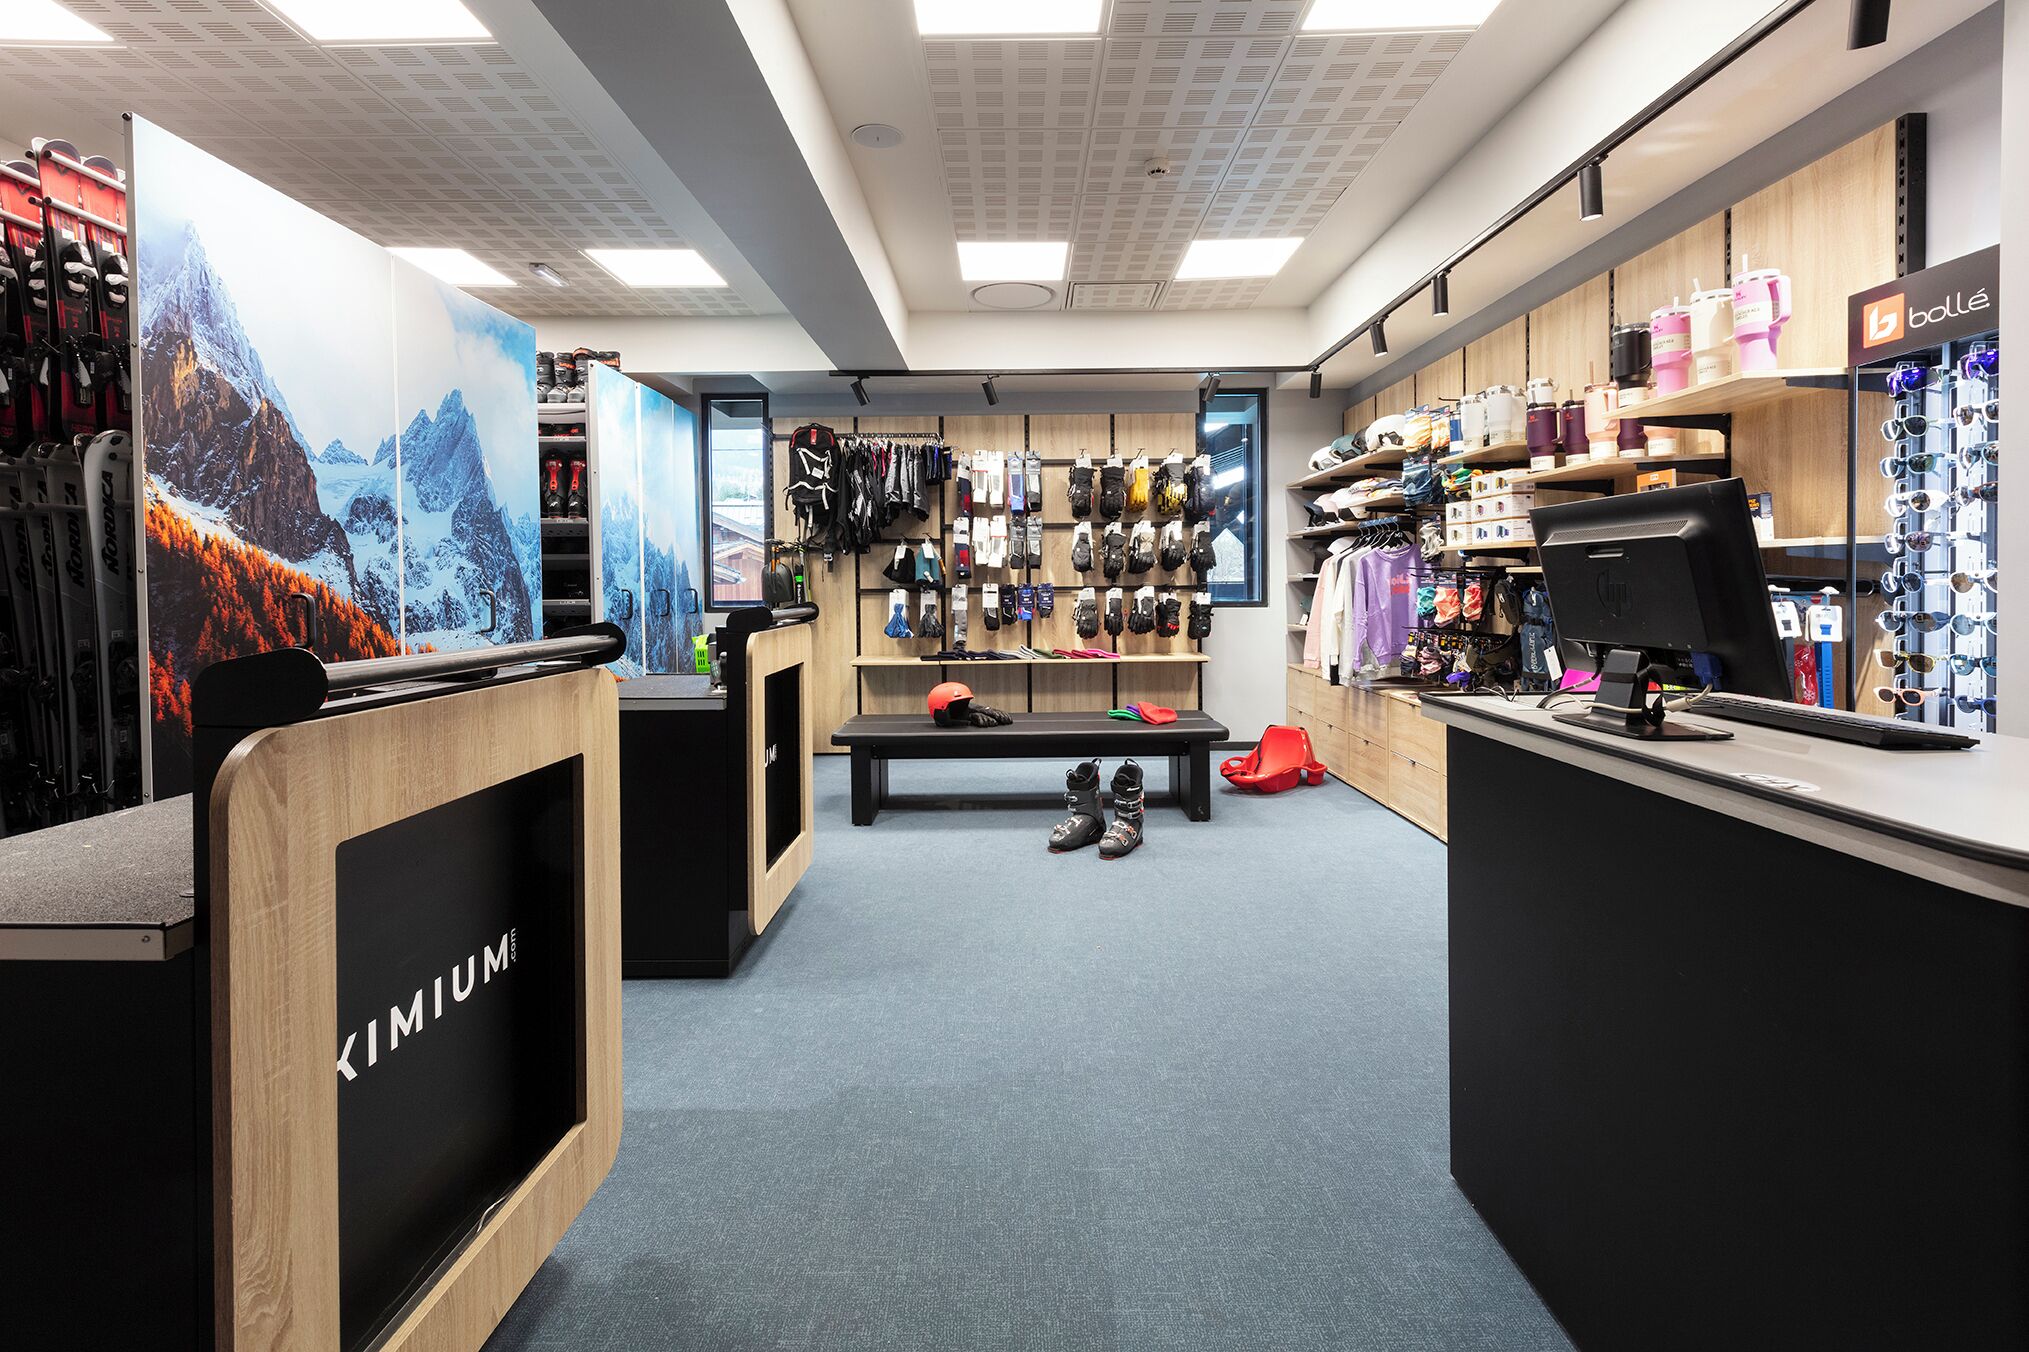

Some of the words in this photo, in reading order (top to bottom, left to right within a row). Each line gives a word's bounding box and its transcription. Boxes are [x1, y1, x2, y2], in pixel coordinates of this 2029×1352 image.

[1908, 287, 1991, 330] bollé
[101, 470, 119, 576] NORDICA
[337, 932, 508, 1082] KIMIUM
